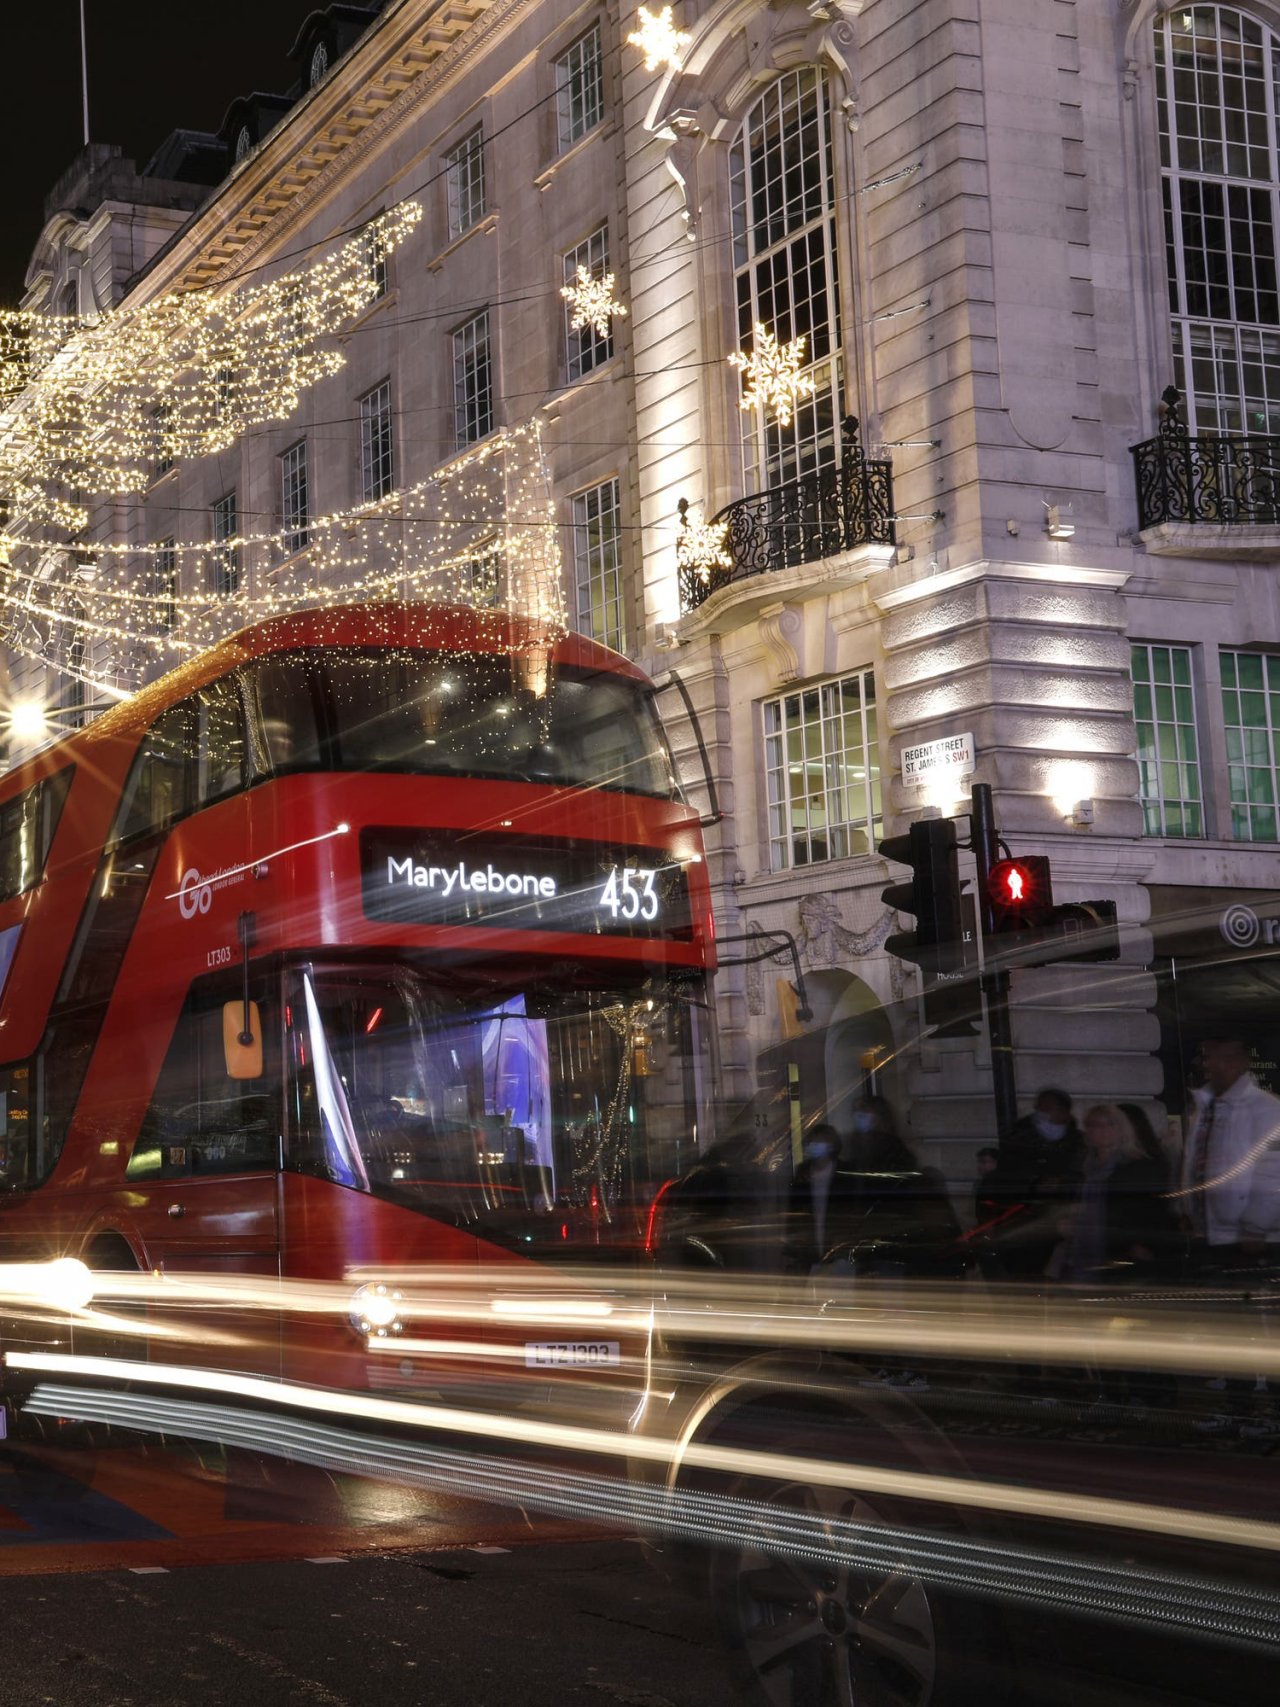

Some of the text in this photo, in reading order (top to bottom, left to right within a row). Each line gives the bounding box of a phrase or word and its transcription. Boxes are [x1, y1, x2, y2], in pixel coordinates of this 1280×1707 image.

[904, 737, 964, 762] REGENT STREET
[952, 749, 969, 763] SW1
[179, 867, 212, 919] Go
[387, 855, 660, 920] Marylebone 453
[207, 946, 231, 967] LT303
[755, 1113, 768, 1128] 33
[535, 1344, 569, 1364] LTZ
